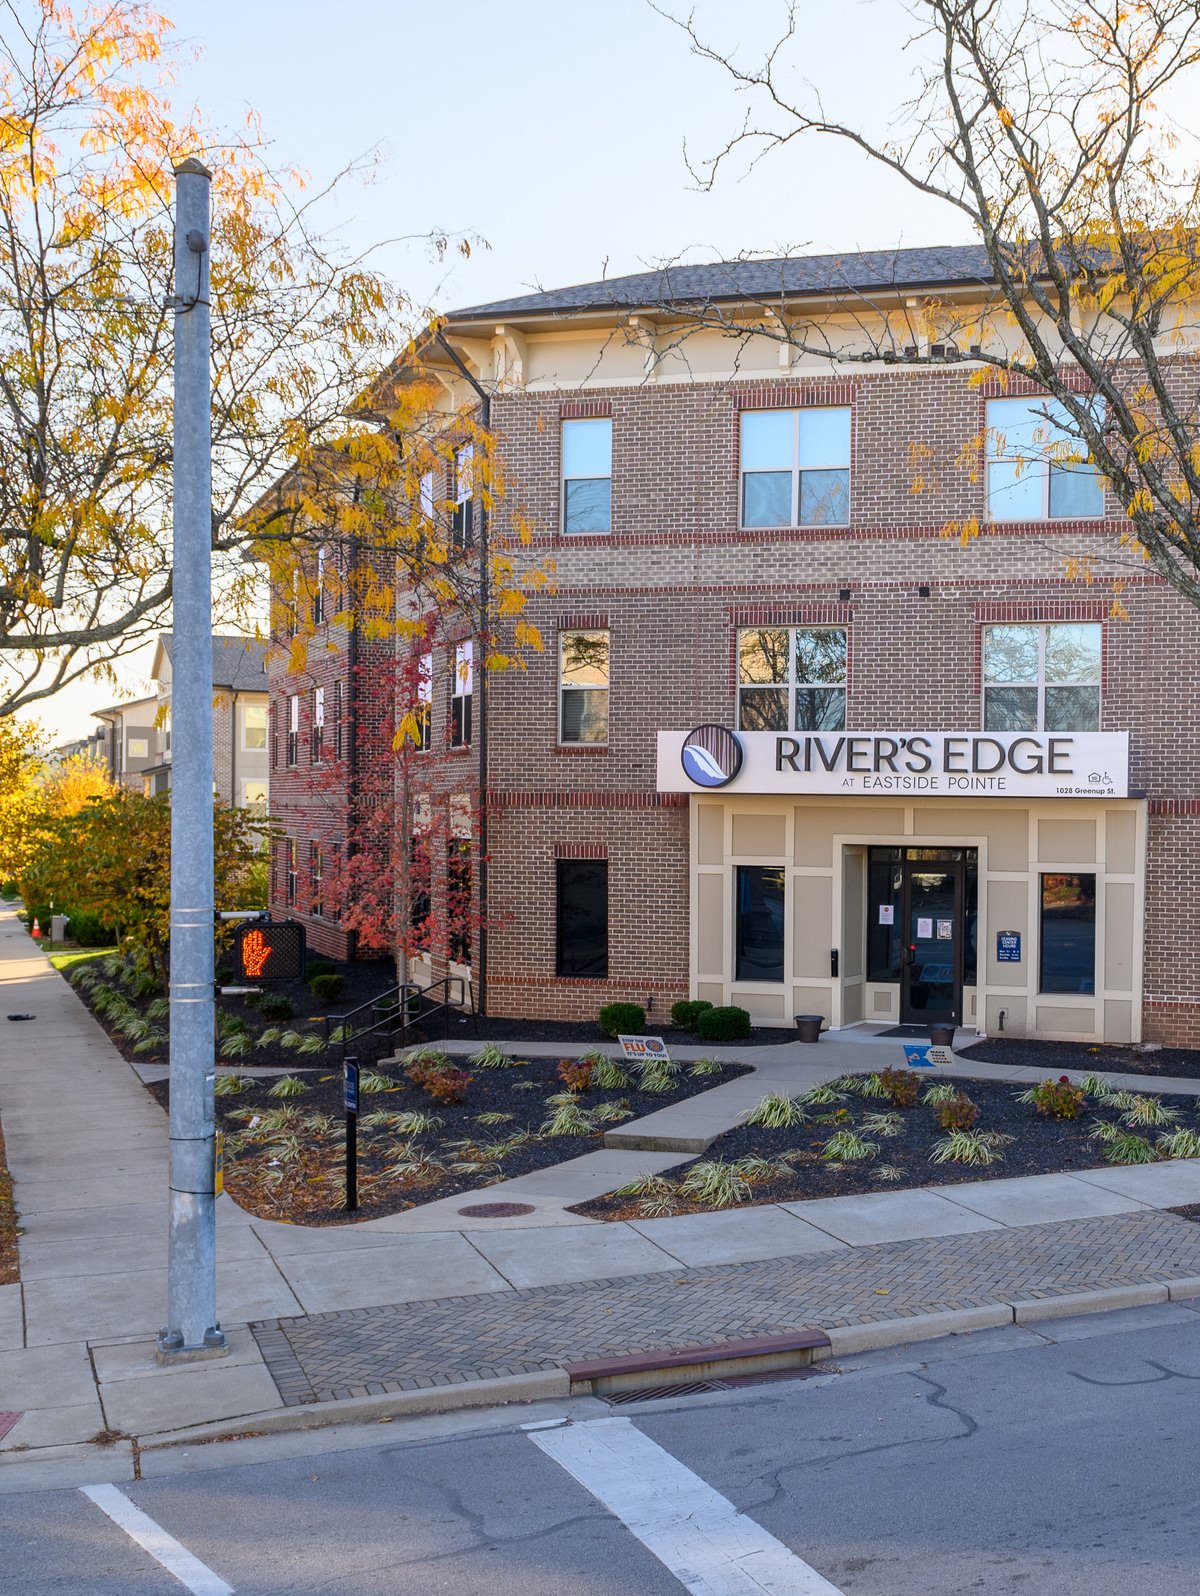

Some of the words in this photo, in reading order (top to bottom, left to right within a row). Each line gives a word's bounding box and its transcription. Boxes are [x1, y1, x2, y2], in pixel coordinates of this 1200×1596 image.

[775, 737, 932, 774] RIVER'S
[943, 737, 1074, 775] EDGE
[842, 778, 855, 787] AT
[863, 776, 939, 789] EASTSIDE
[948, 777, 1006, 790] POINTE
[1074, 787, 1105, 796] Greenup
[1107, 787, 1116, 795] St.
[624, 1042, 646, 1052] FLU
